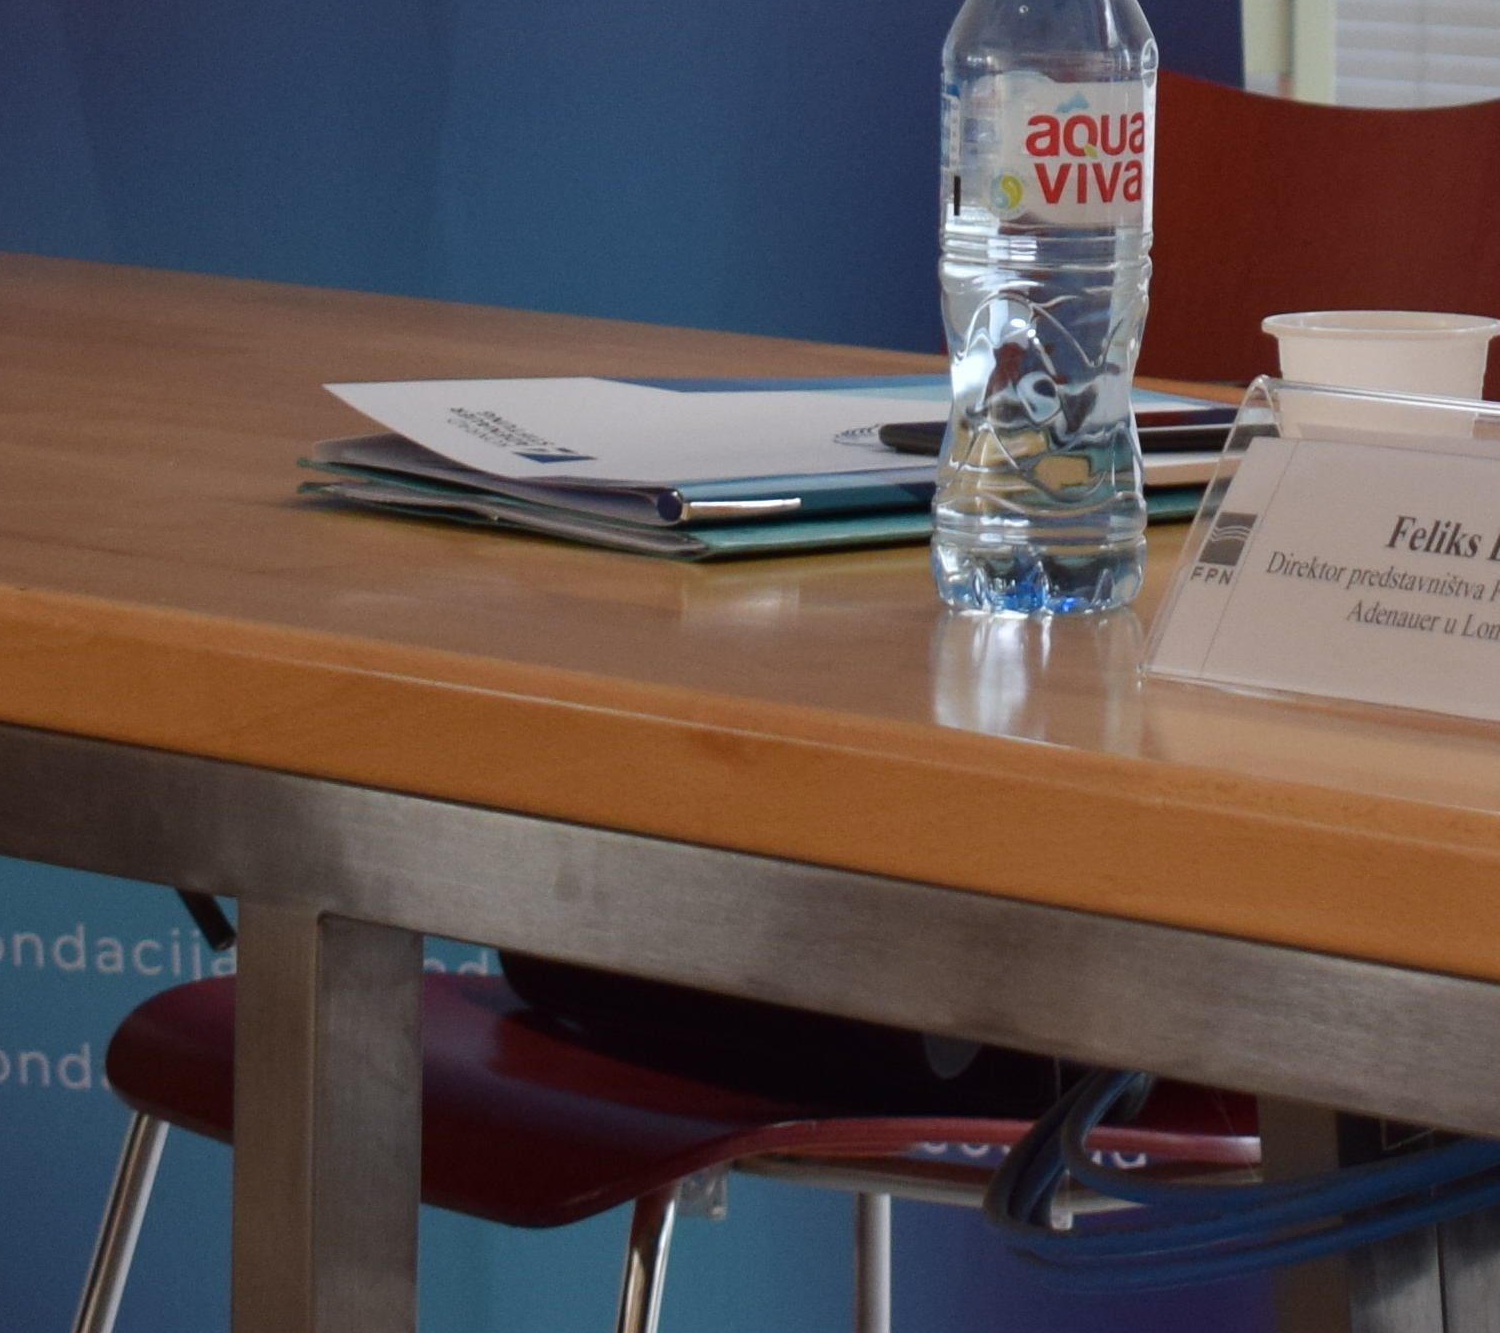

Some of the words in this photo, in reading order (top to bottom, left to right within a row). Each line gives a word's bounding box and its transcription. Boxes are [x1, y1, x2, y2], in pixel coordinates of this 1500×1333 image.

[1025, 111, 1145, 159] aqua
[1384, 514, 1482, 559] Feliks
[1190, 565, 1234, 585] FPN
[1265, 550, 1347, 583] Direktor
[1345, 564, 1486, 602] predstavništva
[1346, 598, 1442, 633] Adenauer
[1443, 617, 1459, 635] u
